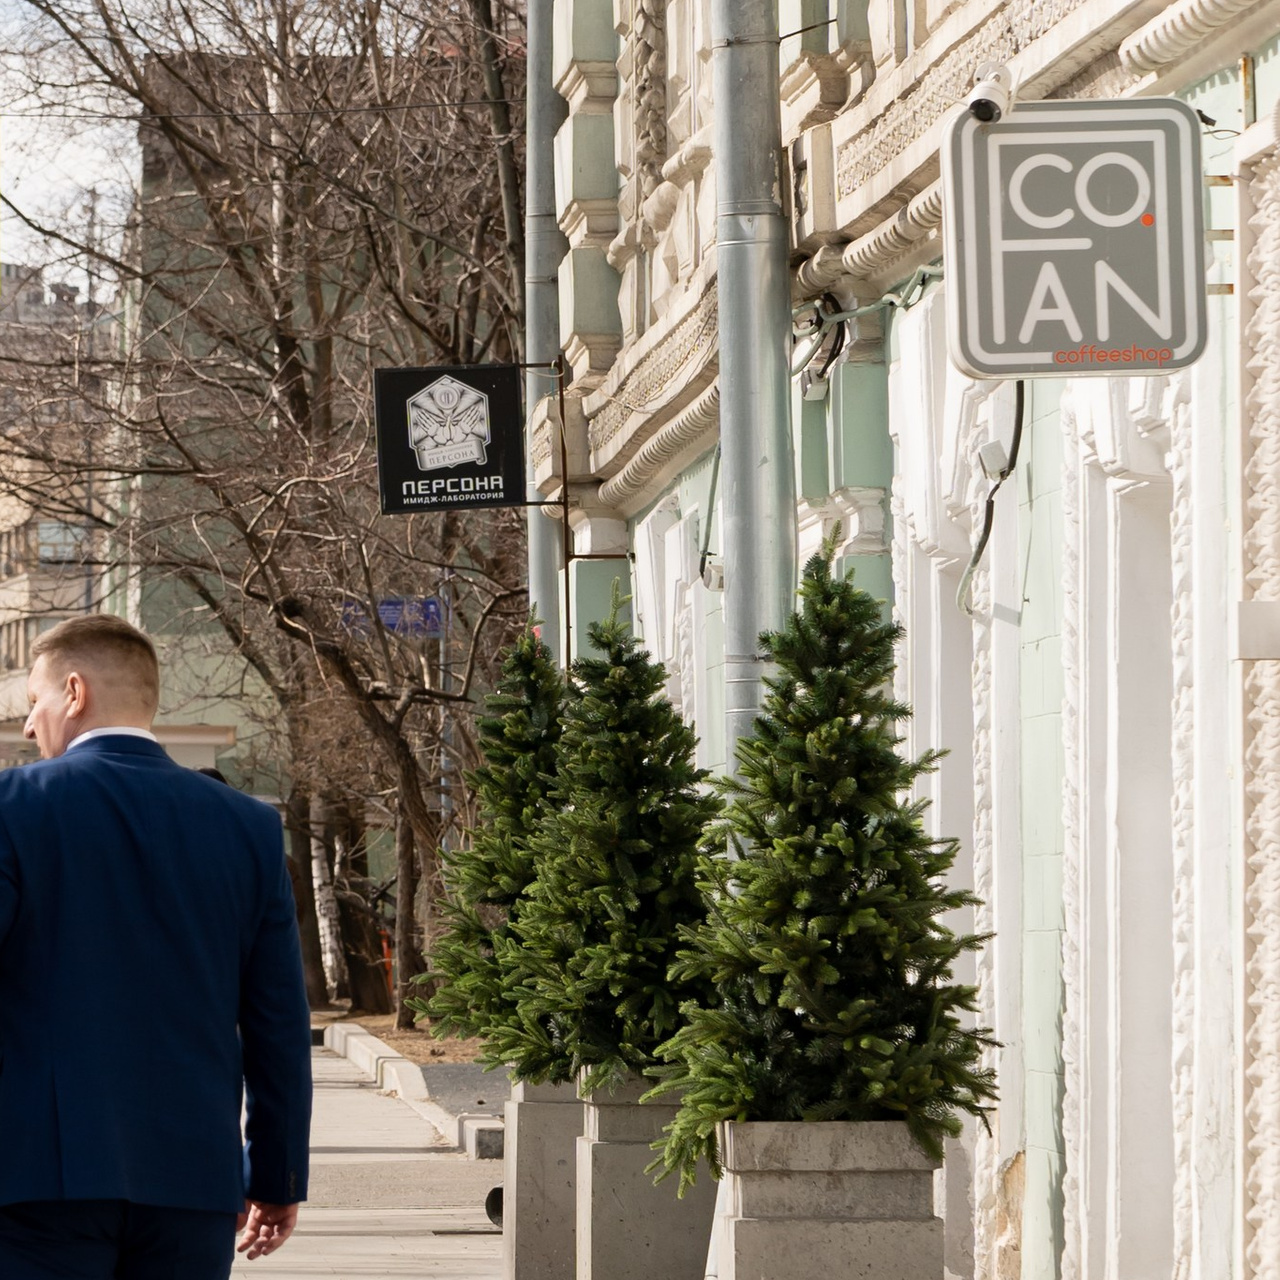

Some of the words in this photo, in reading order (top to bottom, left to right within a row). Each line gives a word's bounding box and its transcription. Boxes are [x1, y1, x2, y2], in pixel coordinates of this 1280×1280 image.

[1055, 343, 1173, 367] coffeeshop
[428, 450, 475, 465] ПЕРСОНА
[402, 475, 504, 495] ПЕРСОНА
[403, 491, 505, 505] ИМИДЖ-ЛАБОРАТОРИЯ
